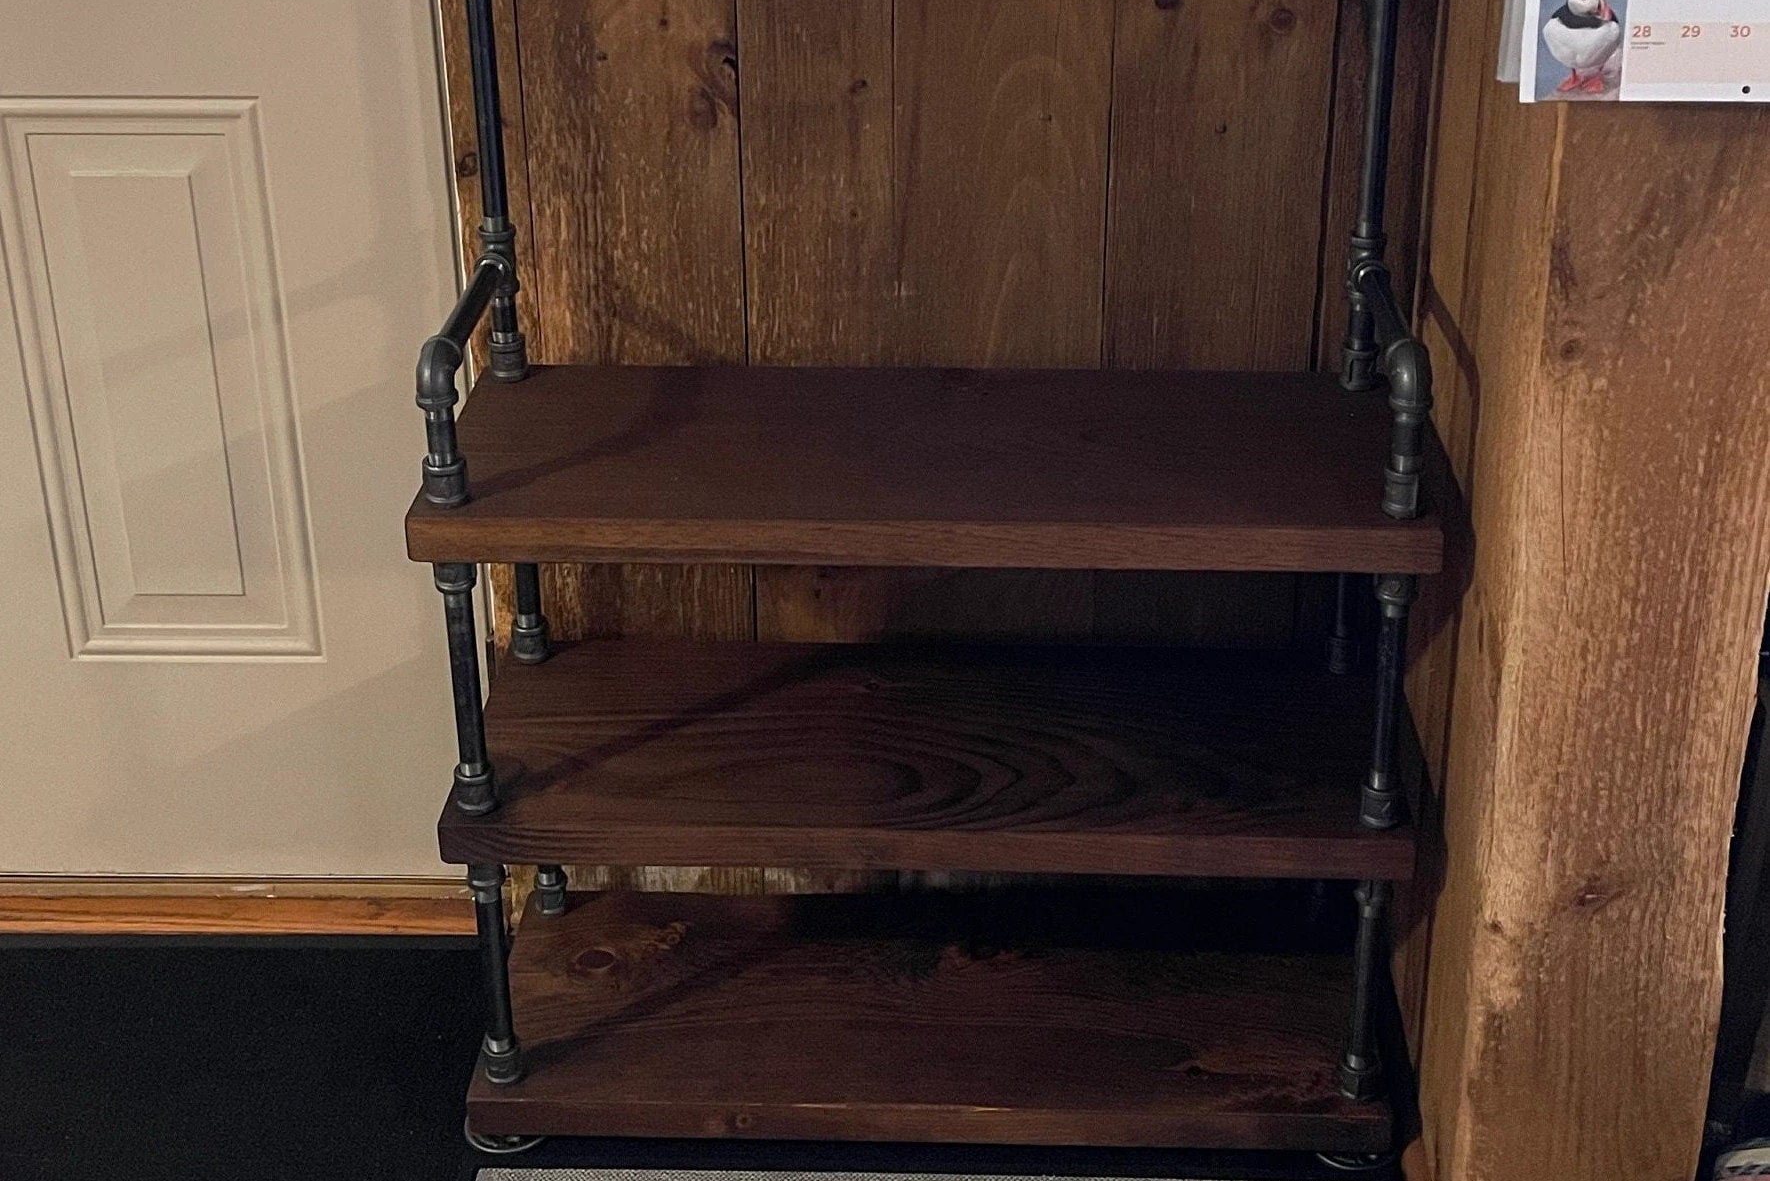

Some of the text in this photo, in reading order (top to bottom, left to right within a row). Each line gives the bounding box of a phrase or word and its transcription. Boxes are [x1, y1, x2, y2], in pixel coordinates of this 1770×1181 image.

[1633, 25, 1750, 38] 28 29 30
